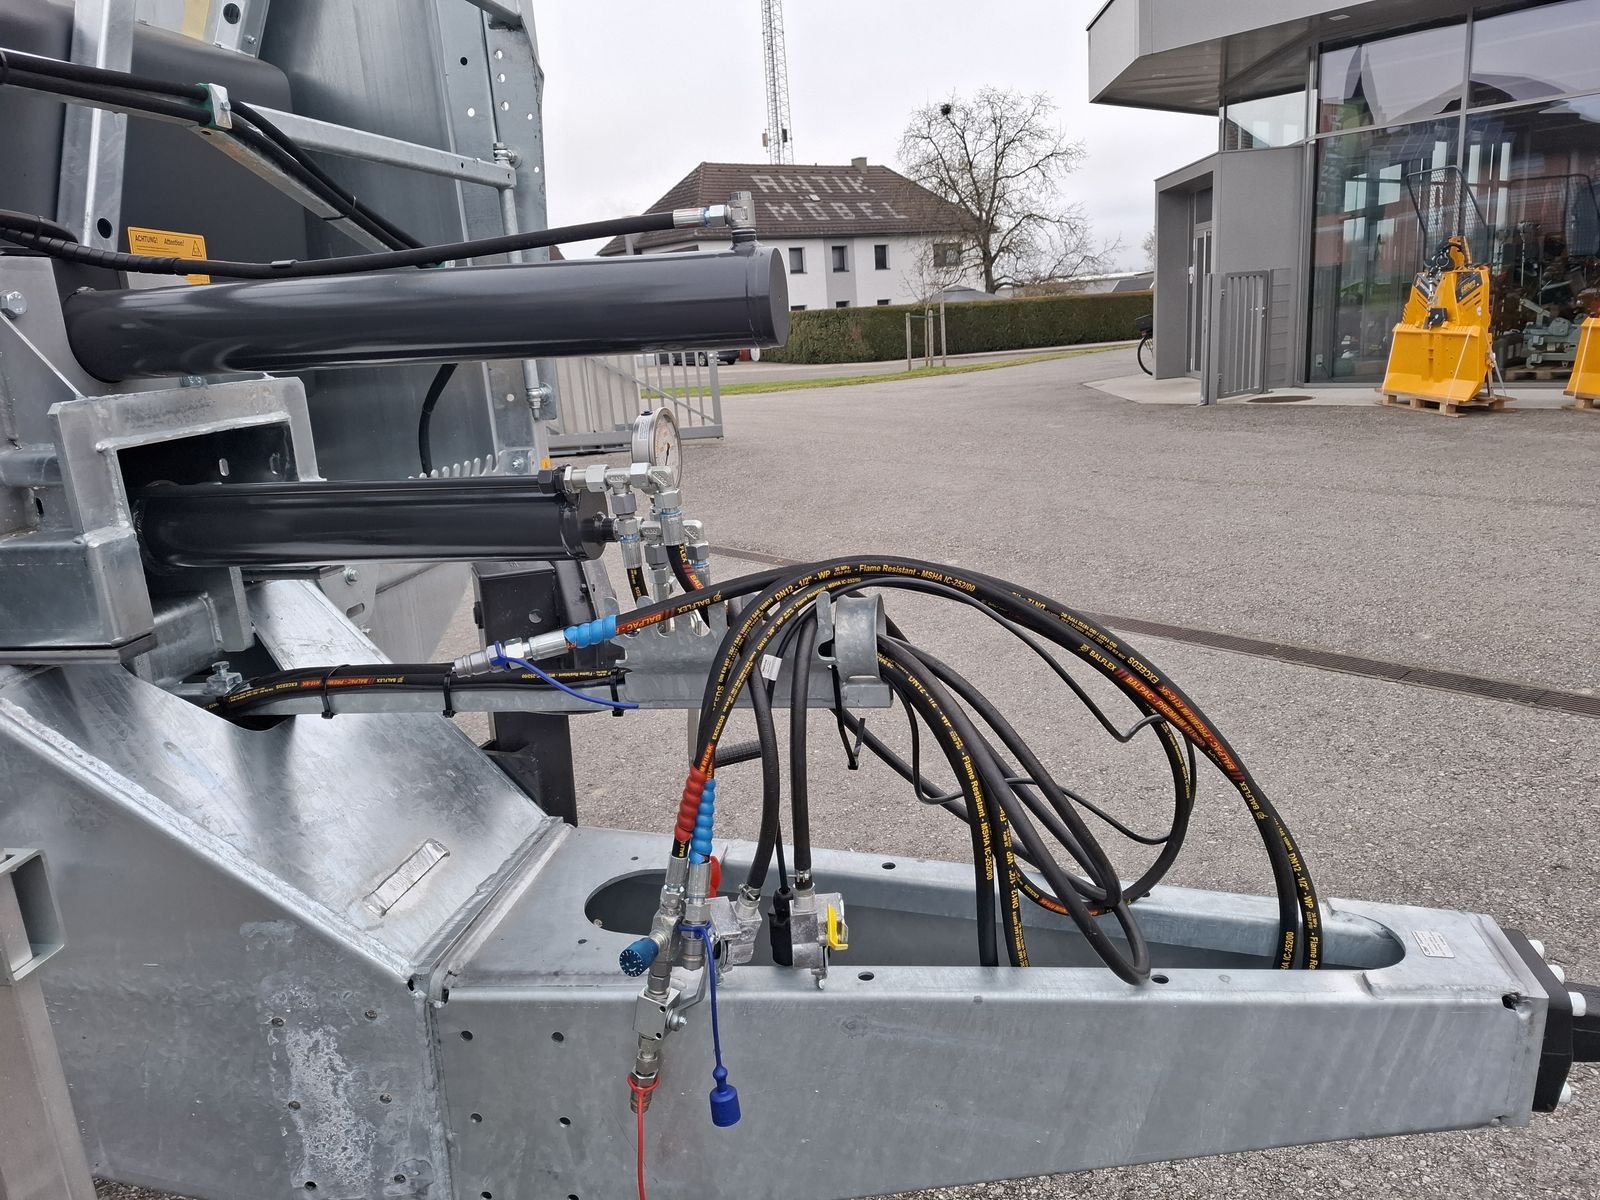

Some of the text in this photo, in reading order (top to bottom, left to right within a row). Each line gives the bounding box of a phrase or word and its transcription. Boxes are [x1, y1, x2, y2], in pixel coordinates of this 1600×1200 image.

[751, 175, 876, 193] ANTIK
[775, 585, 794, 600] DN12
[817, 570, 830, 579] WP
[883, 564, 916, 575] Resistant
[921, 570, 942, 582] MSHA
[944, 576, 976, 592] IC-252/00
[676, 598, 711, 614] BALFLEX
[626, 614, 663, 631] BALPAC
[1128, 656, 1159, 684] EXCEEDS
[1089, 650, 1117, 671] BALFLEX
[1126, 677, 1154, 700] BALPAC
[1155, 700, 1187, 727] PREMIUM
[712, 715, 725, 740] EXCEEDS
[1181, 705, 1211, 738] PREMIUM
[1211, 742, 1235, 770] BALPAC
[962, 756, 975, 780] Flame
[971, 780, 985, 817] Resistant
[980, 822, 991, 846] MSHA
[1240, 781, 1259, 810] BALFLEX
[1006, 851, 1014, 864] WP
[1288, 853, 1302, 872] DN12
[1298, 877, 1309, 890] 1/2"
[1304, 896, 1313, 908] WP
[1011, 889, 1019, 909] DN12
[1283, 931, 1294, 960] IC-252/00
[1309, 936, 1318, 958] Flame
